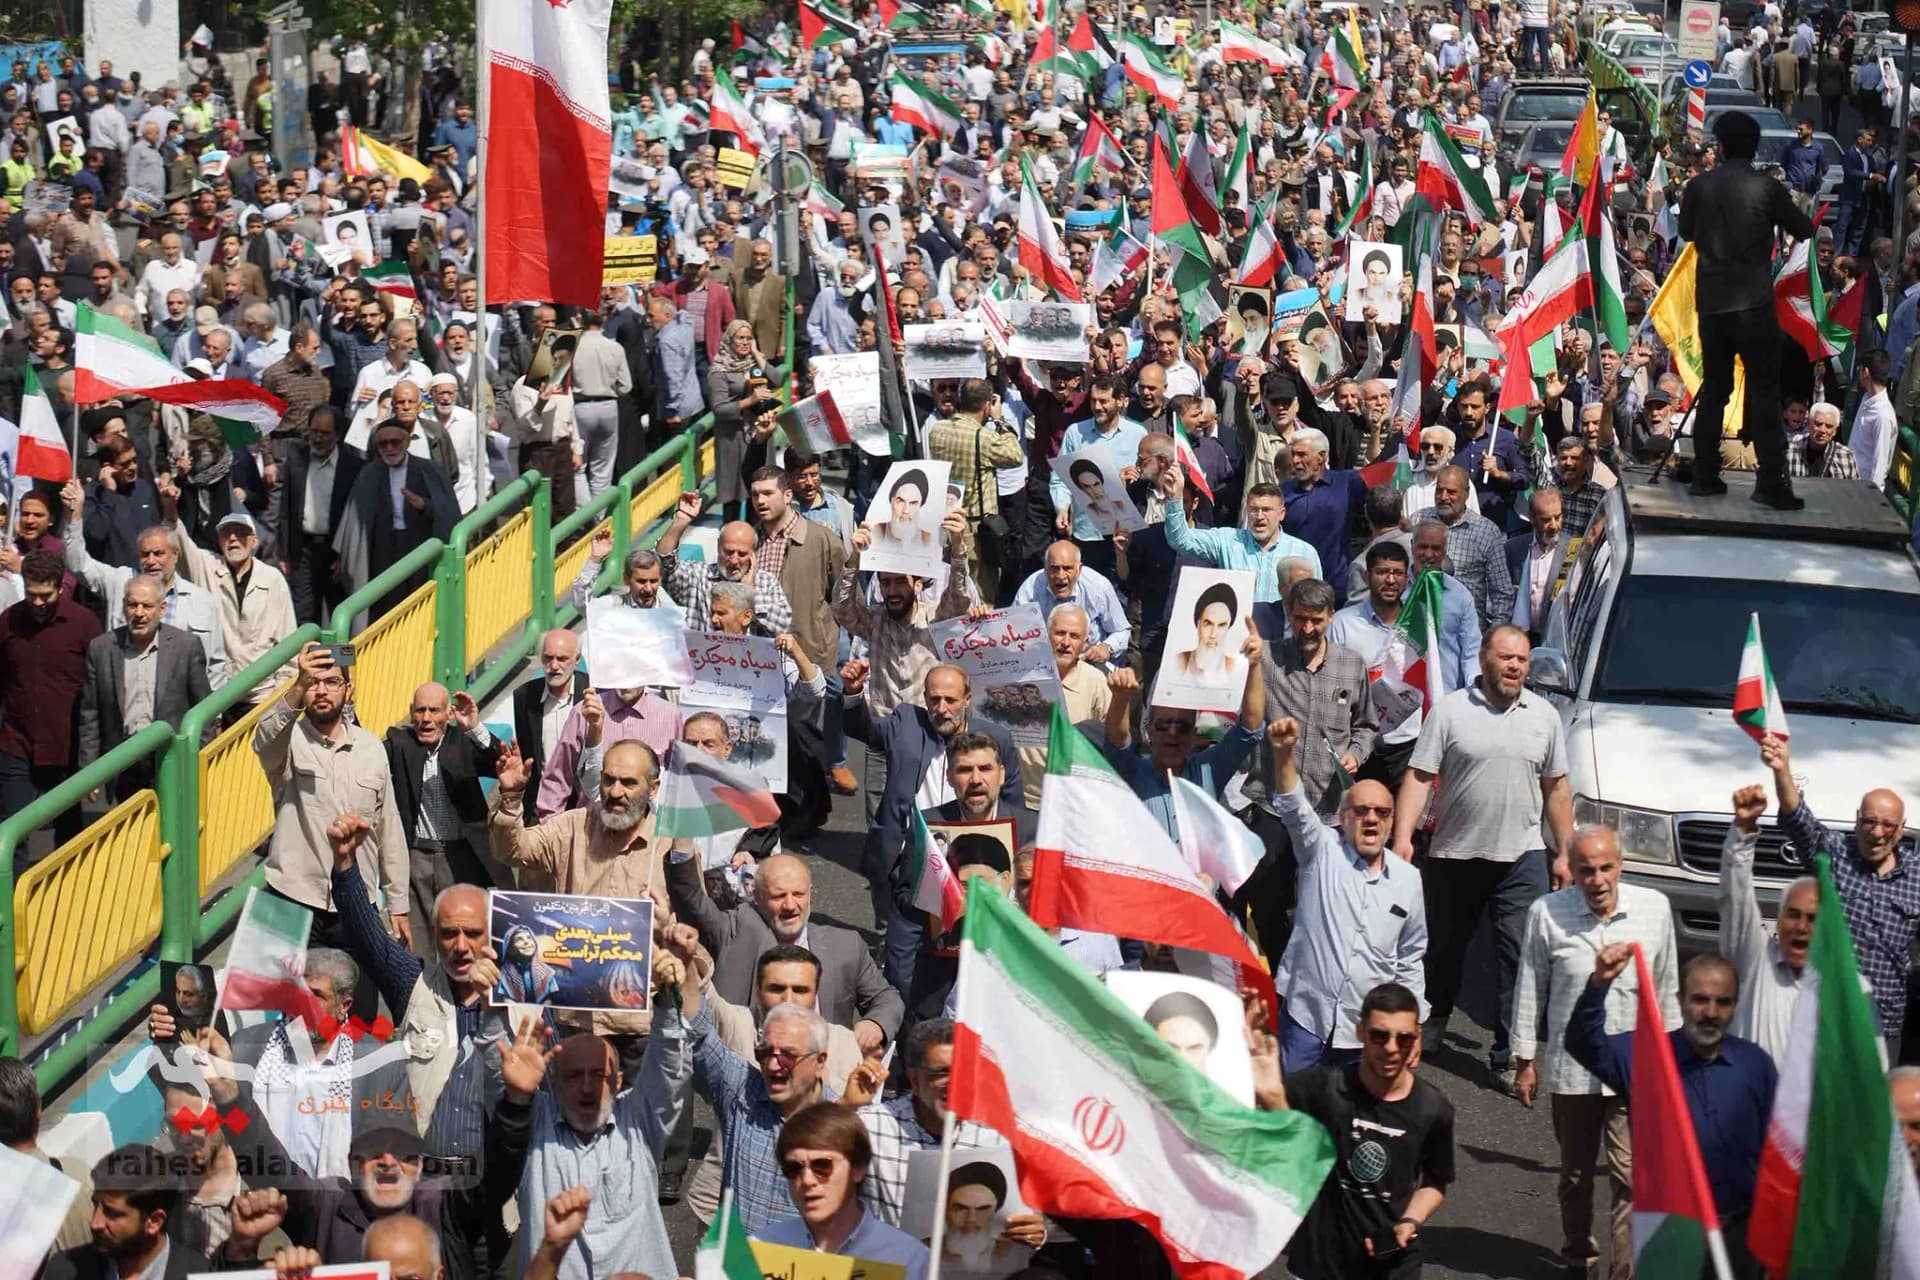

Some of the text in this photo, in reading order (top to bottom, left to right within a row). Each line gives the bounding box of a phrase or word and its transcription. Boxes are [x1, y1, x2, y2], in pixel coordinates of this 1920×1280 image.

[944, 623, 1042, 660] سپاه مچکریم
[740, 649, 777, 678] سپاه
[554, 924, 632, 944] سیلی بعدی
[600, 946, 643, 965] محکم
